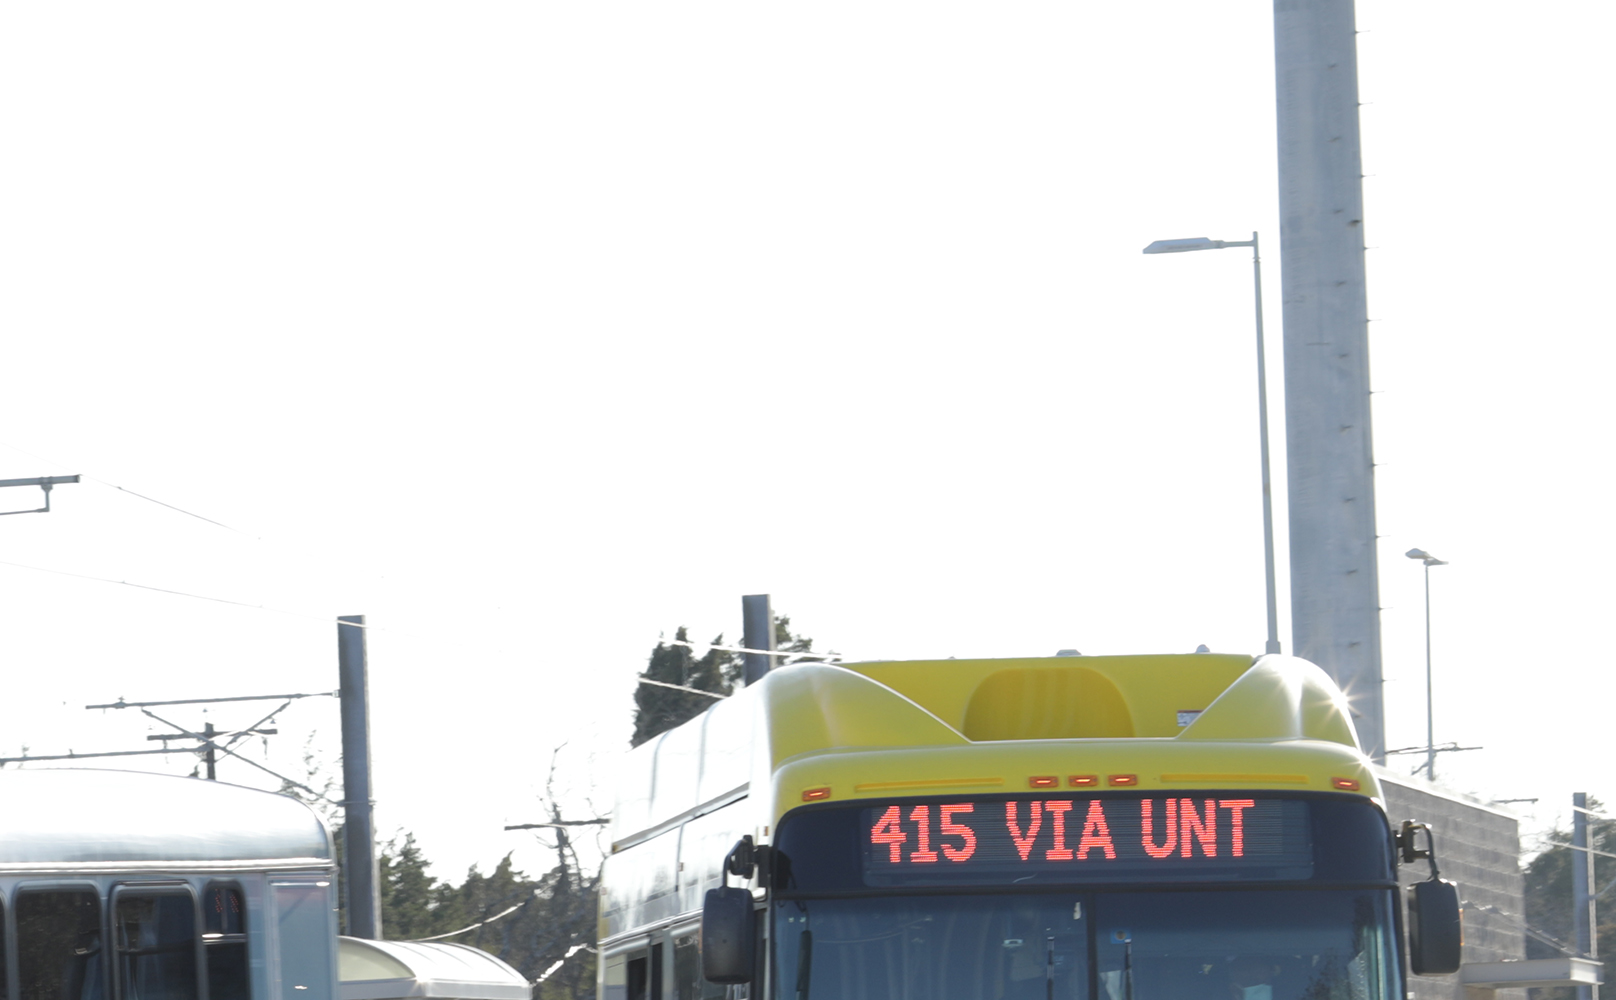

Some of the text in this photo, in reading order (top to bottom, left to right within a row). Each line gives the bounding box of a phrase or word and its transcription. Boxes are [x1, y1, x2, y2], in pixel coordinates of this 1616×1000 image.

[870, 798, 1255, 862] 415 VIA UNT
